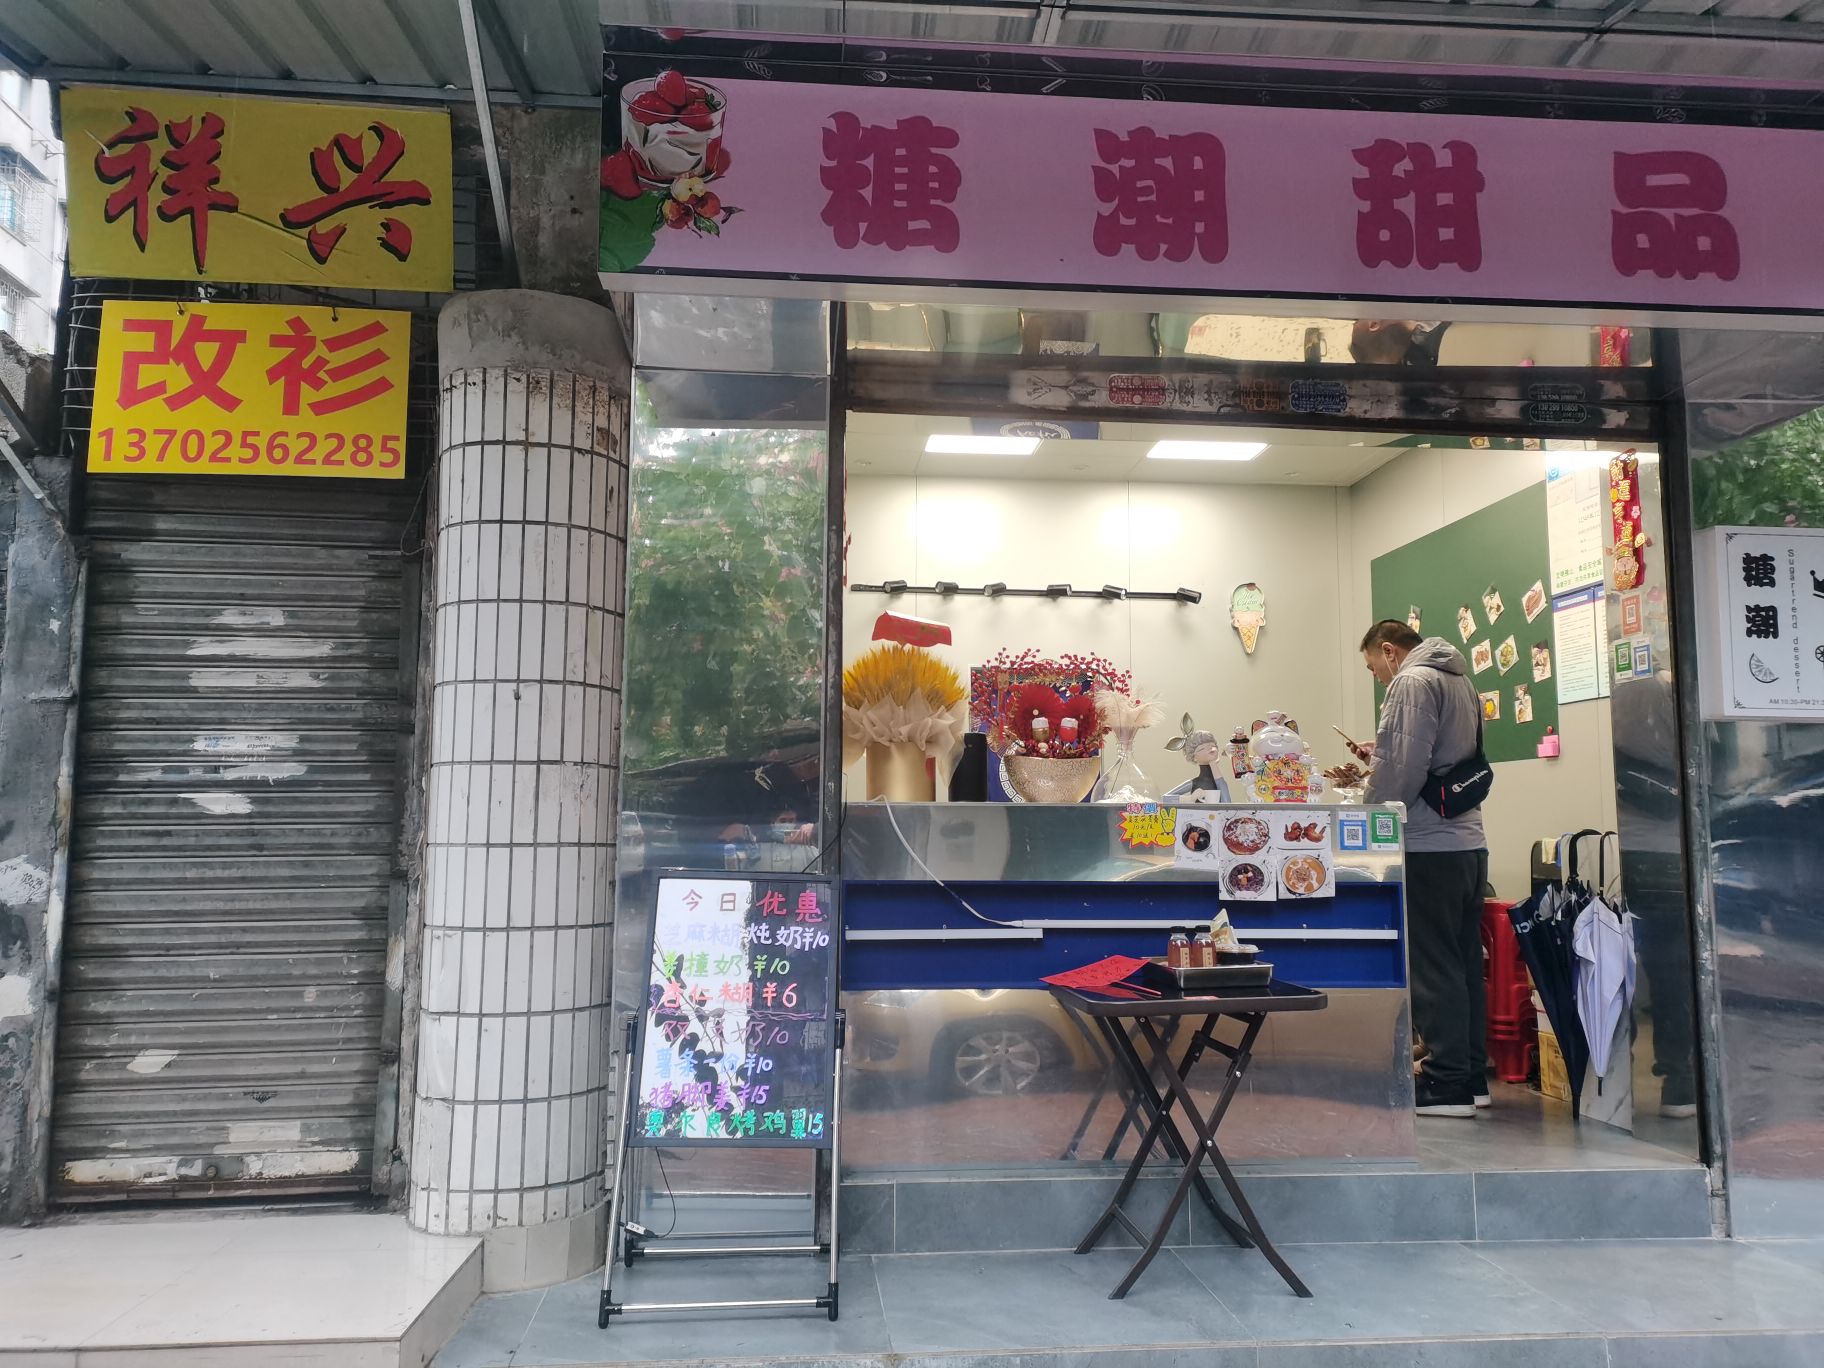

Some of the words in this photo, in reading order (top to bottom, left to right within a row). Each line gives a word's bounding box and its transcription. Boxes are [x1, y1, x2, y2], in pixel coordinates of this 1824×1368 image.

[95, 105, 432, 274] 祥兴
[820, 110, 1741, 282] 糖潮甜品
[116, 313, 395, 417] 改衫
[97, 427, 401, 469] 13702562285
[1742, 552, 1780, 640] 糖潮
[682, 889, 828, 923] 今日优惠
